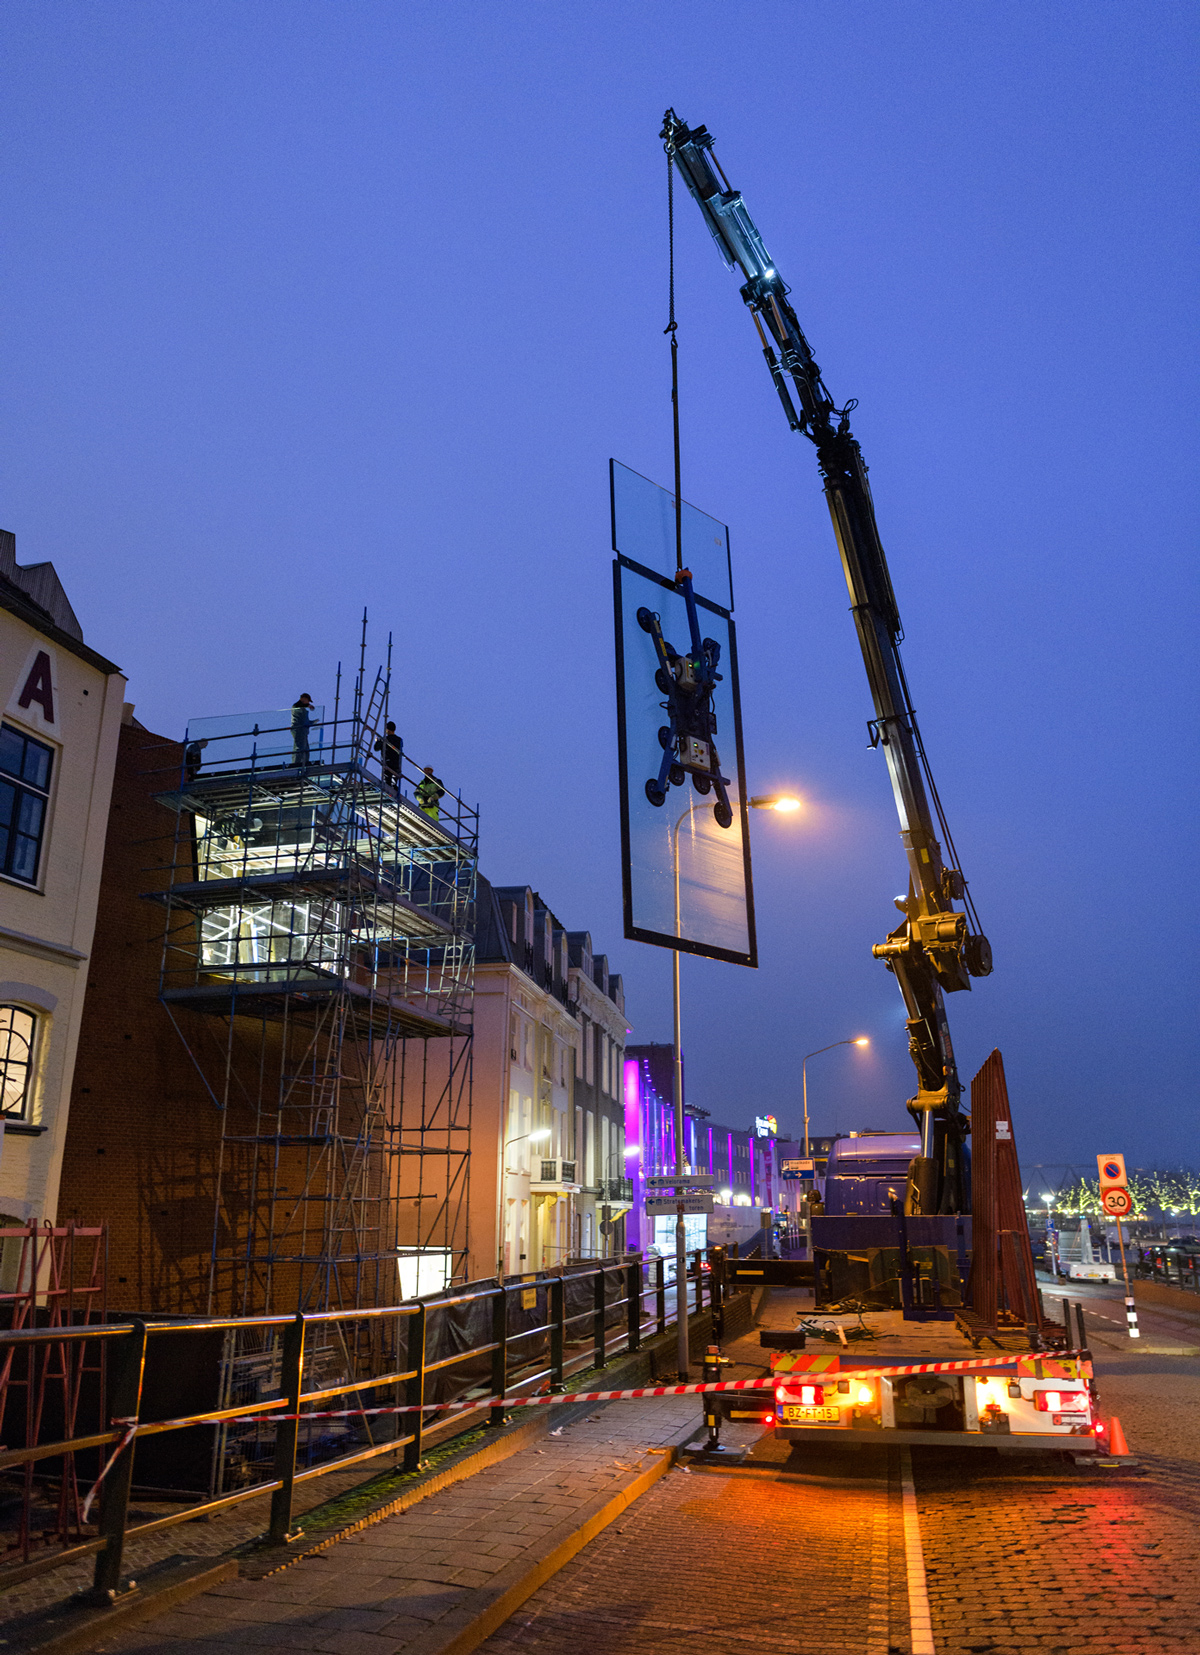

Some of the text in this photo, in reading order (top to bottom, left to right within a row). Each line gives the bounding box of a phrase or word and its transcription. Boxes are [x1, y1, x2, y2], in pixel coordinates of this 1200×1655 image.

[17, 650, 54, 724] A
[1107, 1195, 1126, 1208] 30
[1047, 1219, 1053, 1227] P
[788, 1407, 833, 1419] BZ-FT-15
